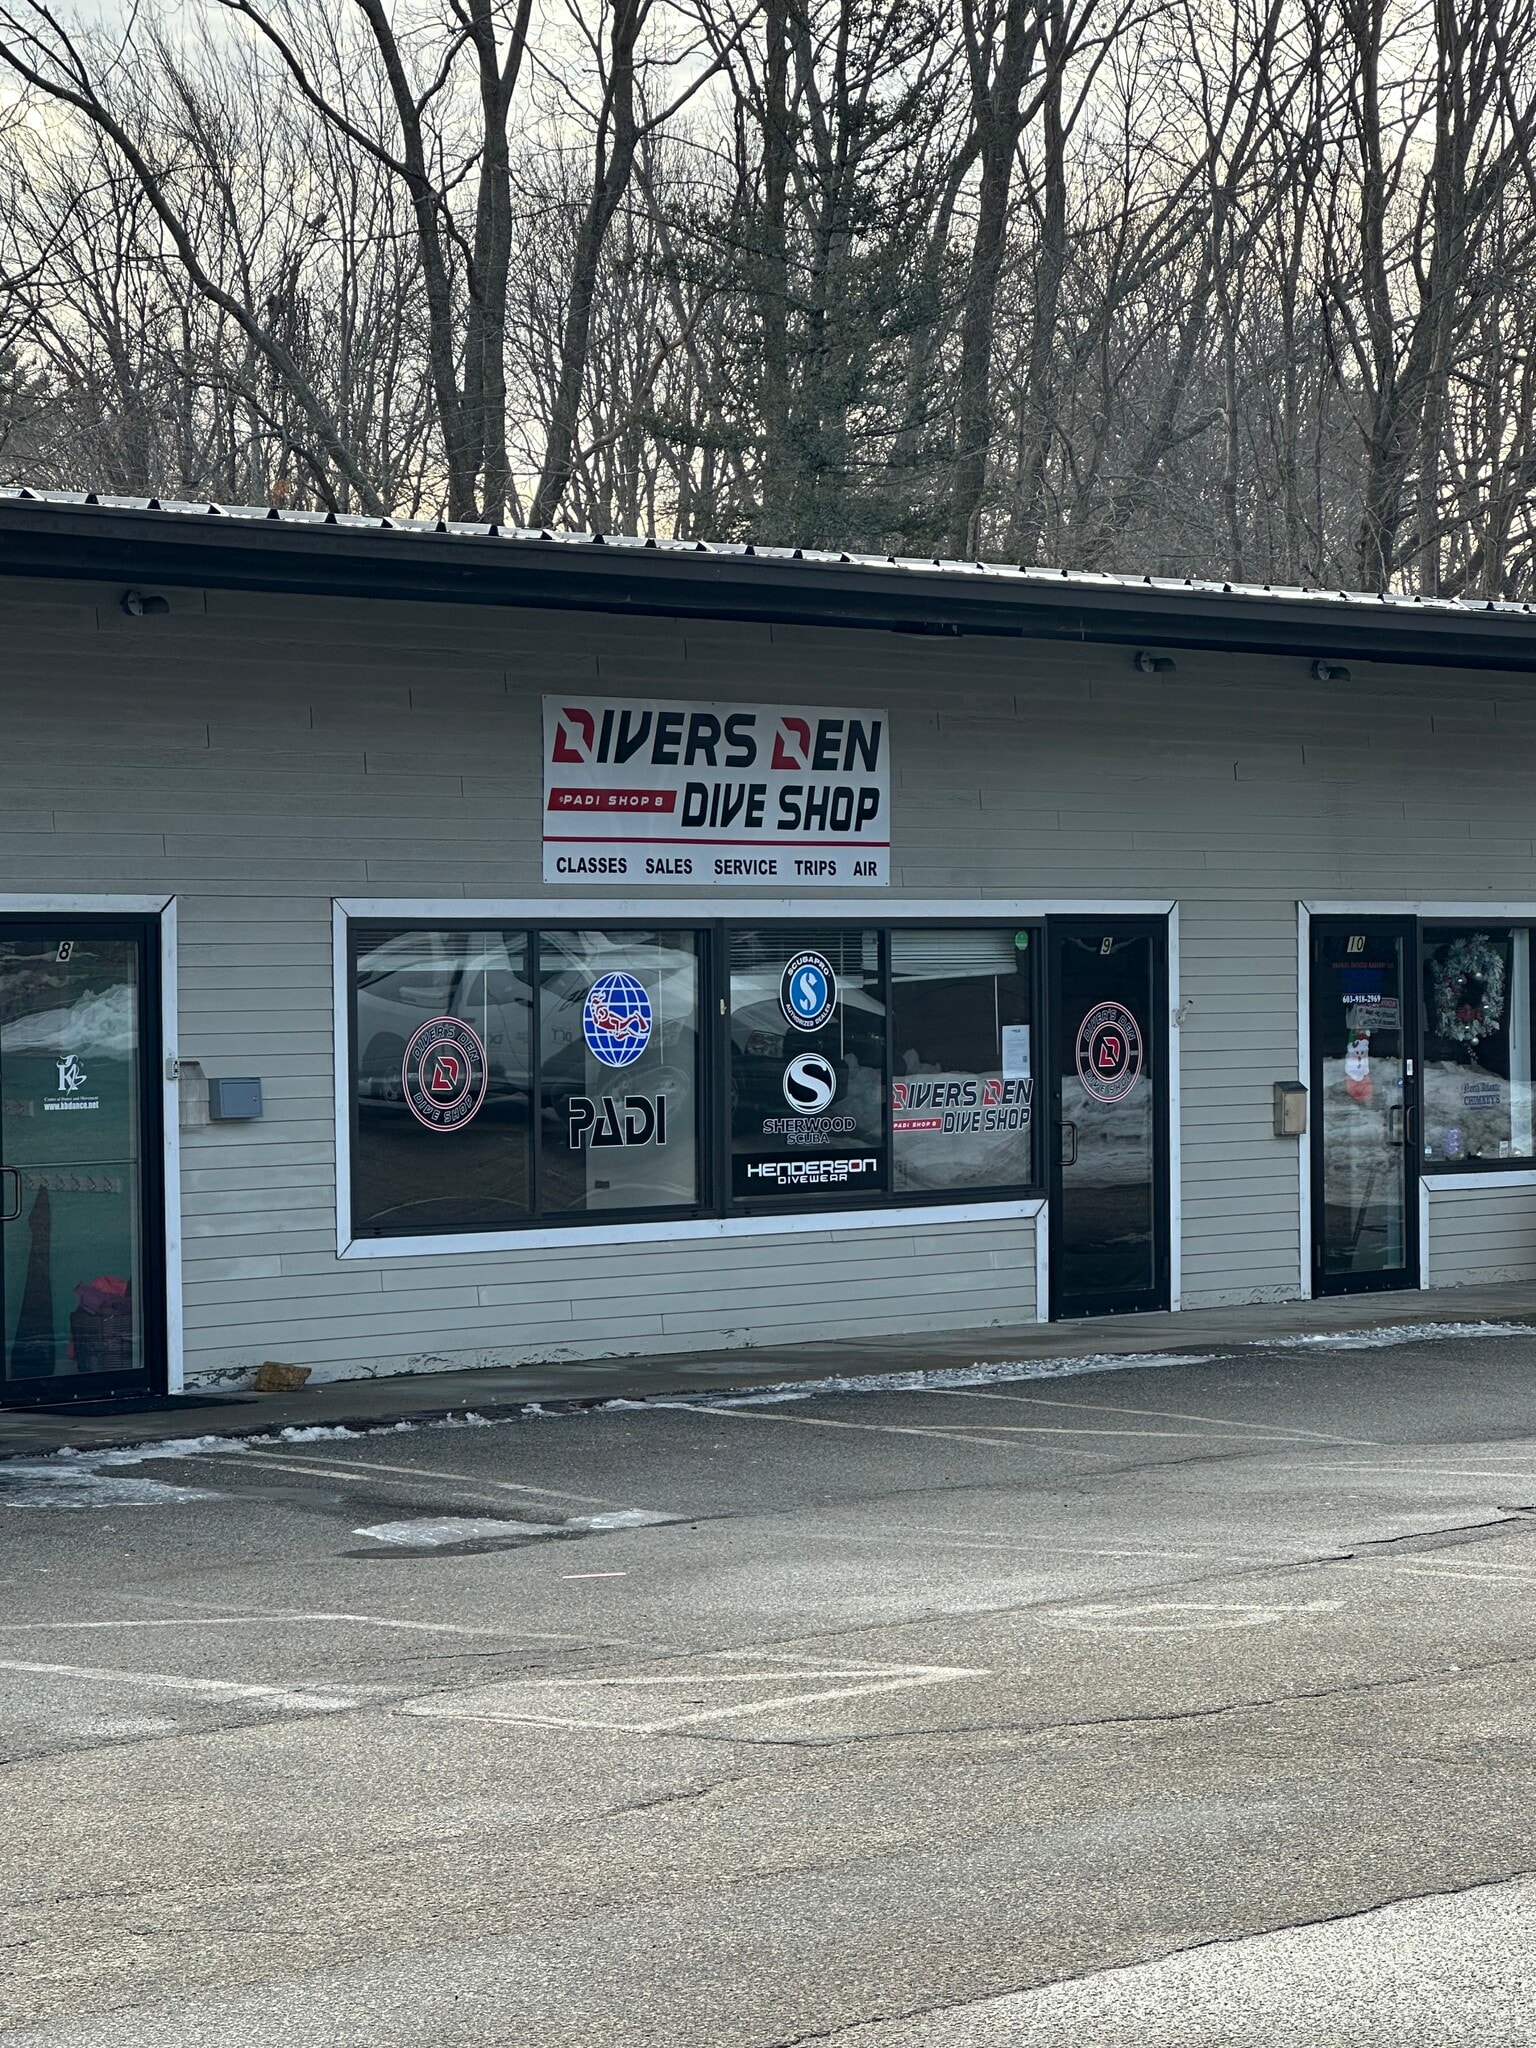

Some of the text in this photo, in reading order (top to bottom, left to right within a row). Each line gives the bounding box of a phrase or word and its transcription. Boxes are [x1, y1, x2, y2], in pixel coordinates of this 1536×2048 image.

[552, 708, 882, 772] DIVERS DEN
[608, 795, 650, 806] SHOP
[681, 782, 880, 832] DIVE SHOP
[556, 857, 878, 877] CLASSES SALES SERVICE TRIPS AIR
[59, 942, 71, 960] 8
[1103, 938, 1111, 953] 9
[1349, 937, 1364, 952] 10
[787, 956, 830, 976] SCUBAPRO
[786, 1003, 832, 1027] AUTHORIZED DEALER
[1118, 1014, 1137, 1041] DEN
[412, 1024, 481, 1062] DIVER'S DEN
[1109, 1069, 1132, 1095] SHOP
[892, 1078, 1033, 1111] DIVERS DEN
[413, 1092, 473, 1123] DIVE SHOP
[569, 1094, 667, 1150] PADI
[763, 1116, 857, 1134] SHERWOOD
[893, 1121, 910, 1129] PADI
[942, 1106, 1031, 1134] DIVE SHOP
[787, 1132, 830, 1145] SCUBA
[747, 1158, 877, 1177] HENDERSON
[778, 1173, 848, 1185] DIVEWEAR
